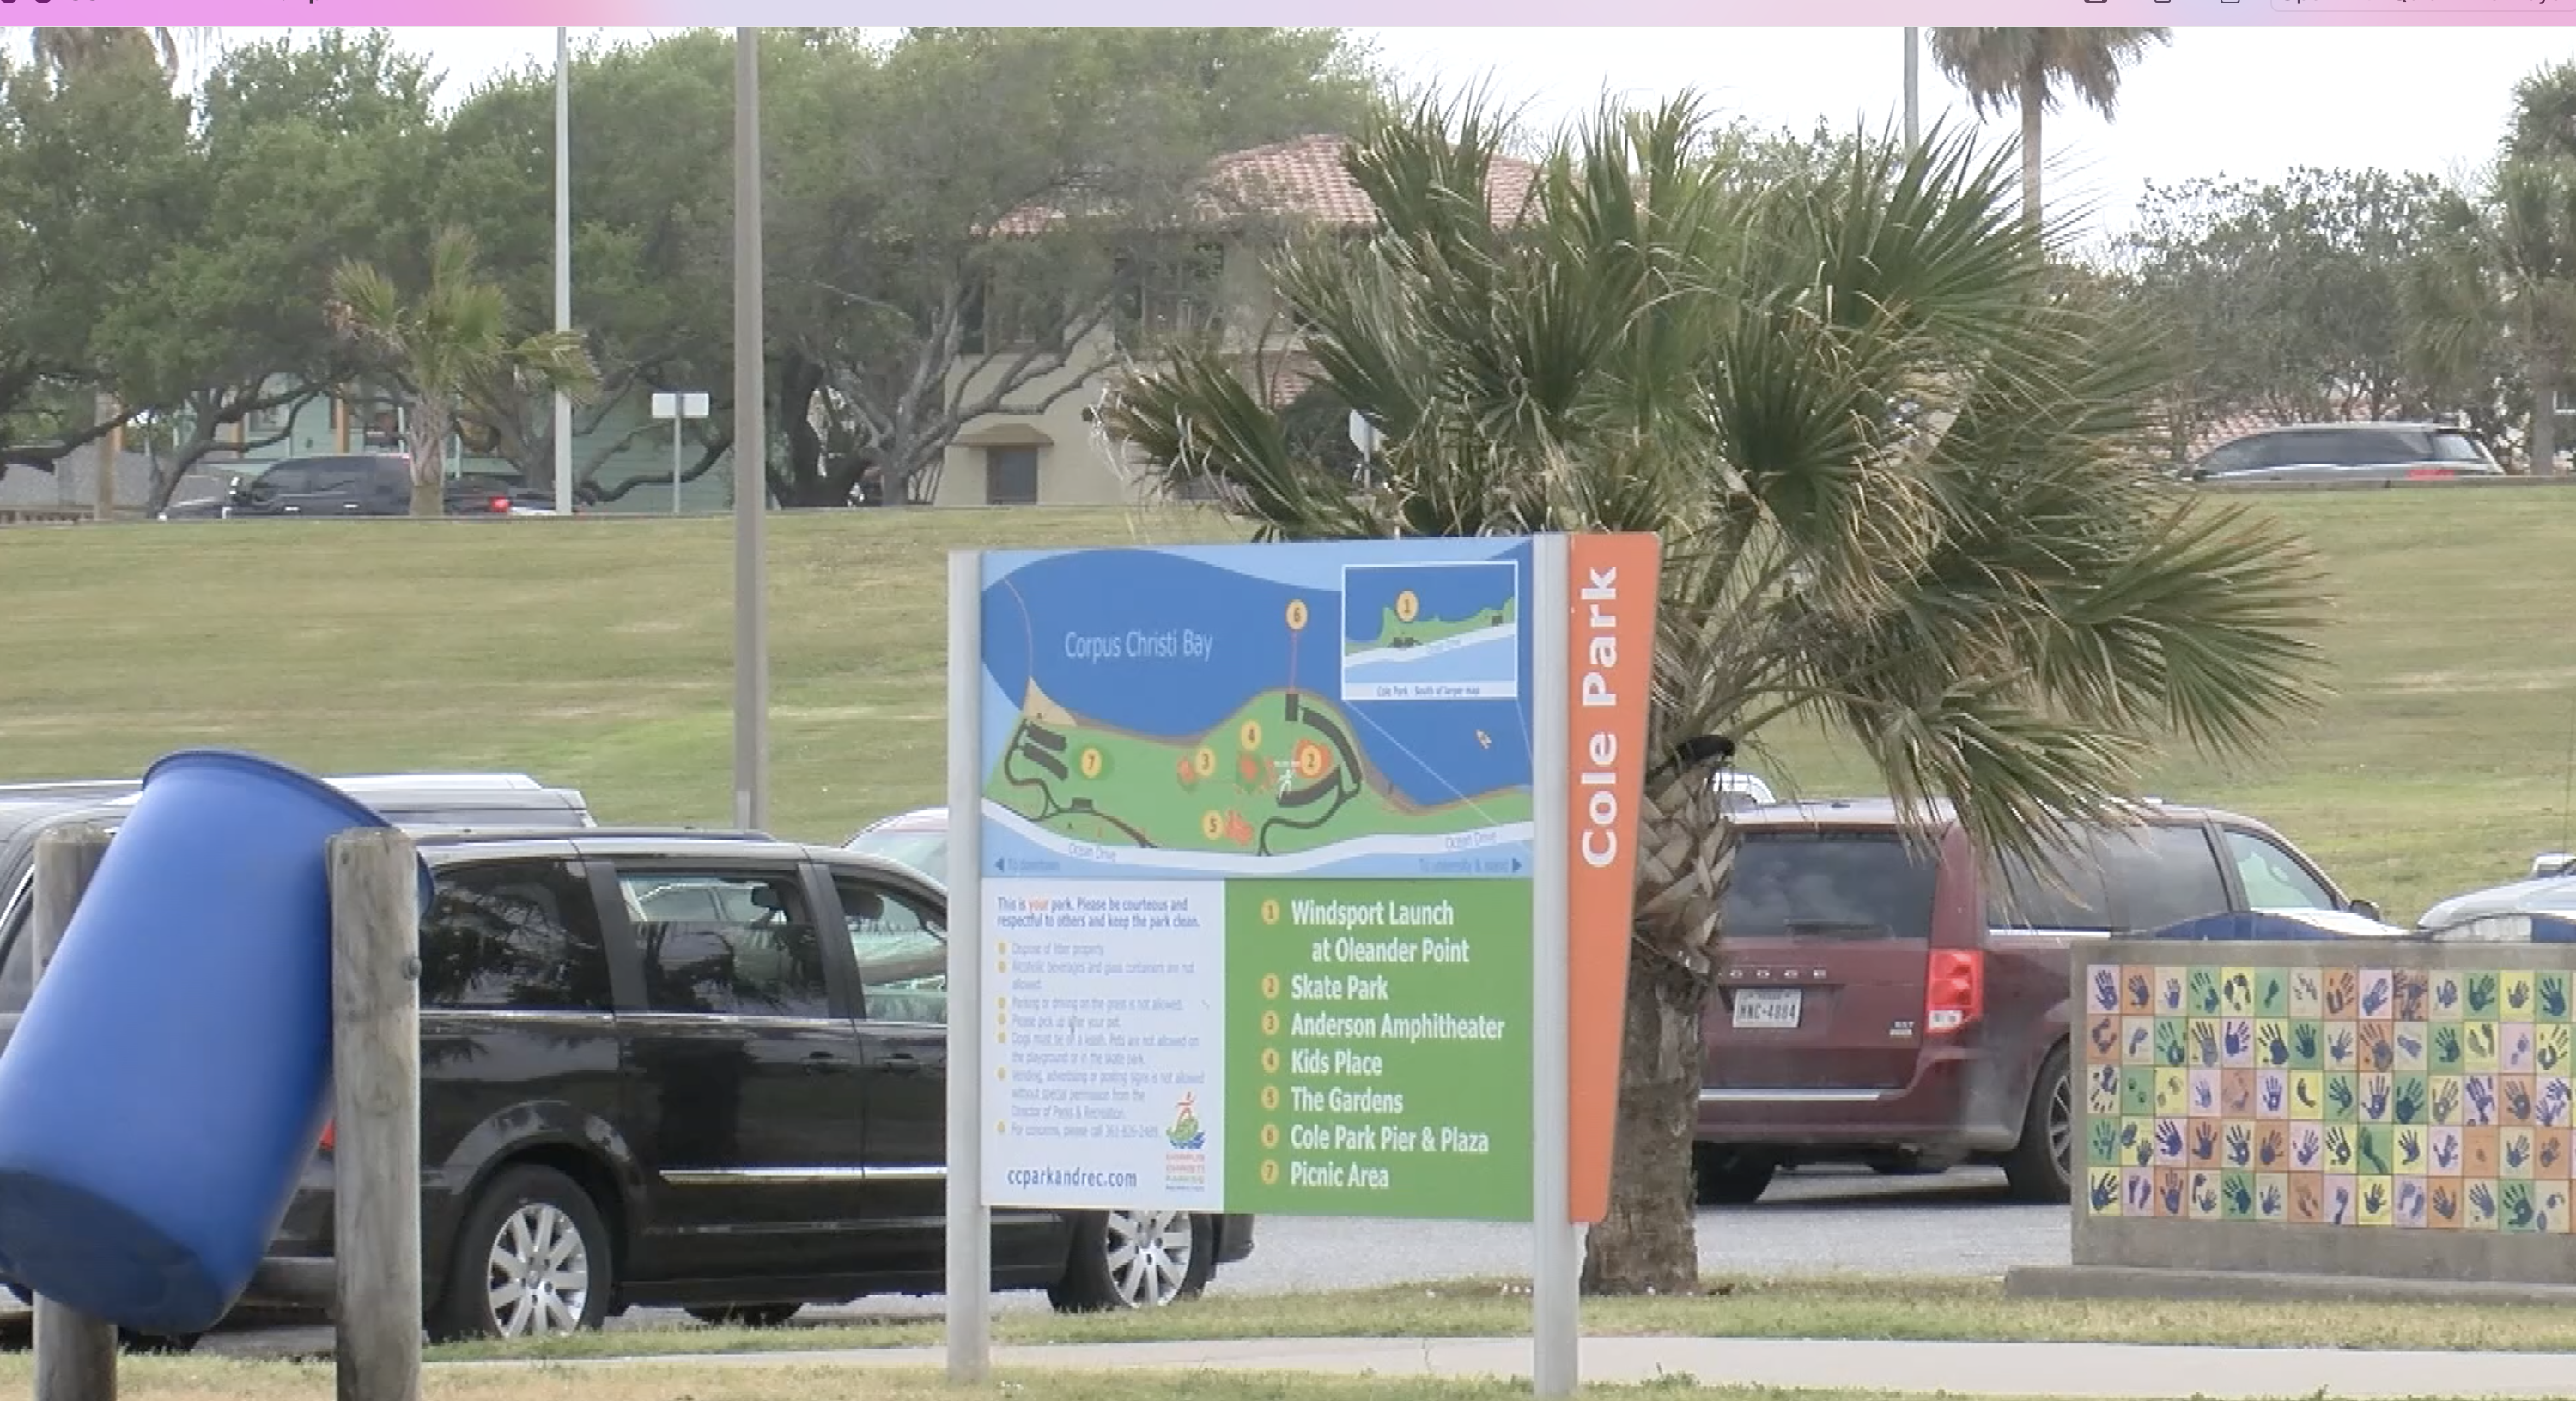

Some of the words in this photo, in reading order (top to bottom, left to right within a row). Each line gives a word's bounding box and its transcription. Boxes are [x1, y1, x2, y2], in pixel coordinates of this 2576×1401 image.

[1065, 631, 1121, 664] Corpus
[1126, 628, 1177, 658] Christi
[1183, 628, 1213, 663] Bay
[1581, 566, 1617, 706] Park
[1581, 731, 1617, 868] Cole
[998, 896, 1016, 911] This
[1018, 896, 1026, 911] is
[1028, 899, 1048, 913] your
[1051, 896, 1074, 913] park.
[1077, 896, 1106, 911] Please
[1109, 896, 1120, 911] be
[1122, 896, 1167, 911] courteous
[1170, 896, 1188, 911] and
[1291, 899, 1385, 930] Windsport
[1388, 900, 1455, 925] Launch
[997, 913, 1042, 930] respectful
[1045, 914, 1054, 927] to
[1057, 913, 1085, 927] others
[1088, 913, 1105, 927] and
[1108, 913, 1129, 930] keep
[1132, 913, 1146, 927] the
[1150, 913, 1169, 930] park
[1311, 937, 1332, 962] at
[1334, 937, 1418, 963] Oleander
[1422, 937, 1470, 963] Point
[1291, 973, 1342, 1000] Skate
[1346, 973, 1389, 1001] Park
[1291, 1011, 1376, 1036] Anderson
[1380, 1013, 1505, 1044] Amphitheater
[1291, 1048, 1330, 1075] Kids
[1334, 1048, 1382, 1076] Place
[1291, 1085, 1325, 1112] The
[1328, 1086, 1404, 1114] Gardens
[1291, 1123, 1330, 1149] Cole
[1334, 1124, 1376, 1151] Park
[1381, 1125, 1417, 1152] Pier
[1420, 1126, 1437, 1152] &
[1440, 1126, 1490, 1153] Plaza
[1007, 1166, 1138, 1190] ccparkandrec.com
[1291, 1161, 1345, 1188] Picnic
[1347, 1161, 1389, 1189] Area
